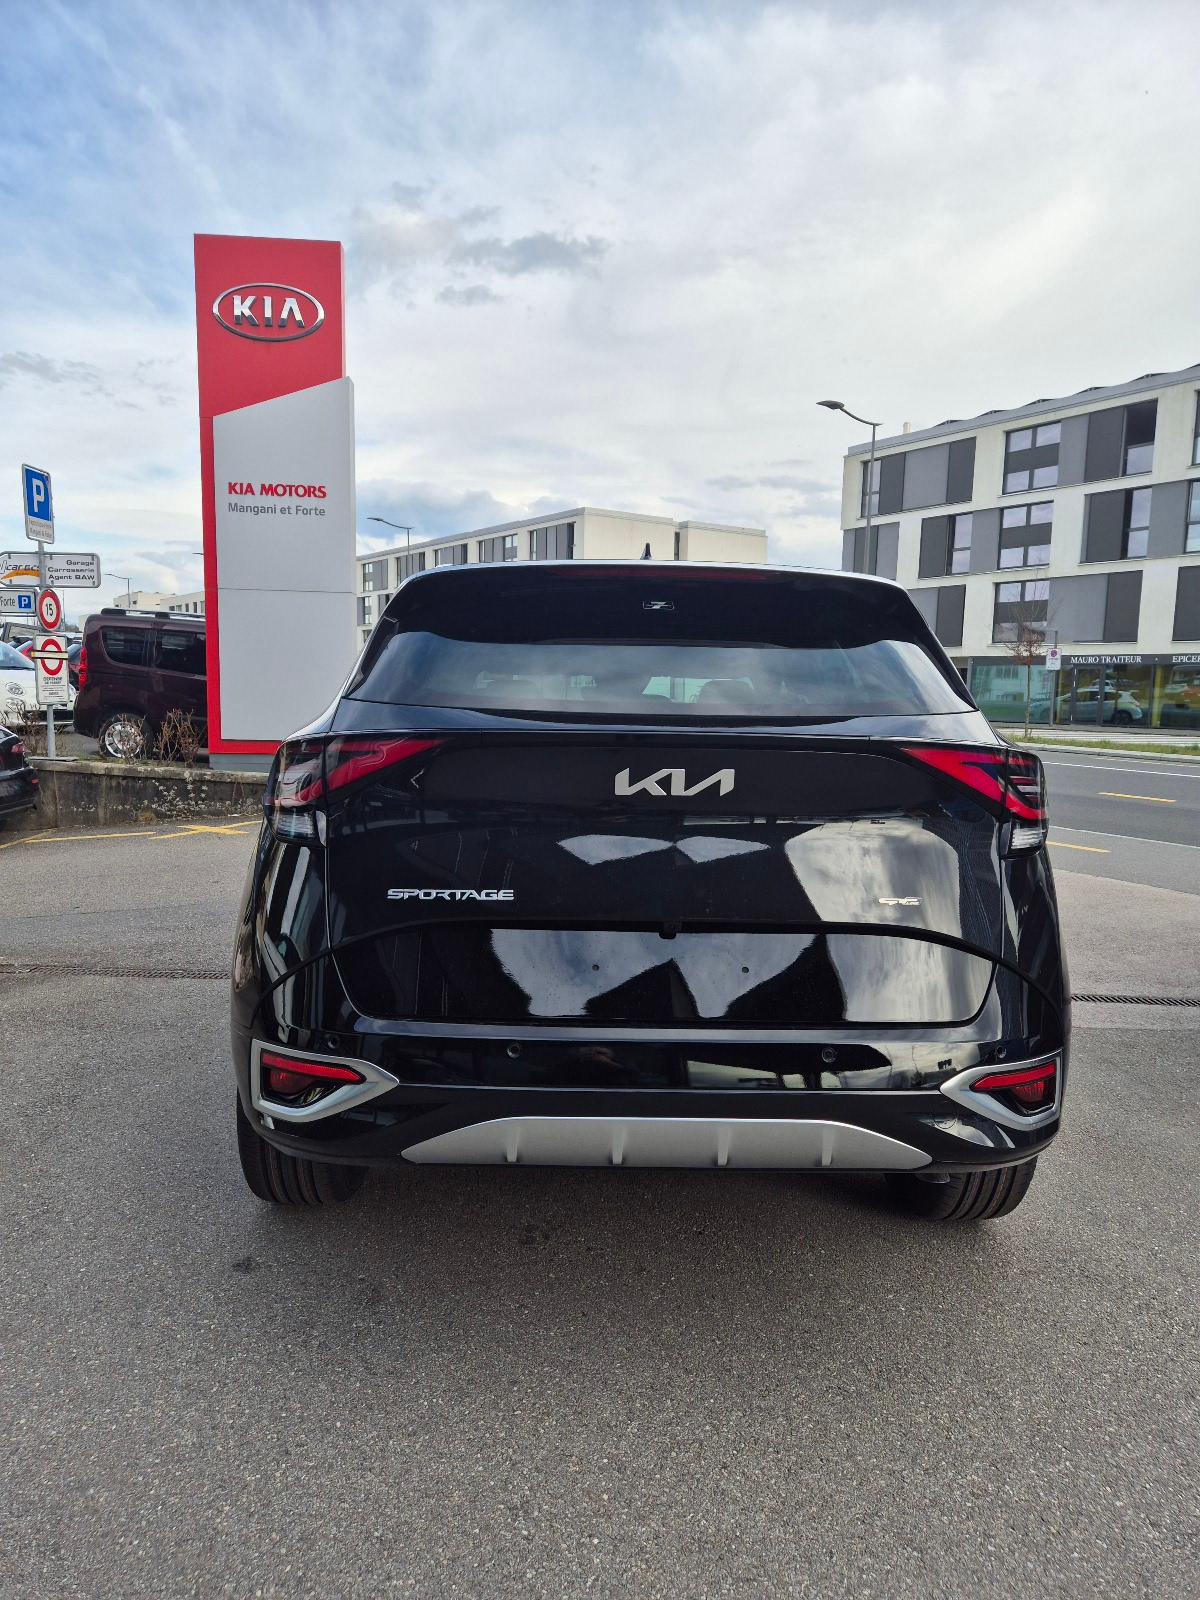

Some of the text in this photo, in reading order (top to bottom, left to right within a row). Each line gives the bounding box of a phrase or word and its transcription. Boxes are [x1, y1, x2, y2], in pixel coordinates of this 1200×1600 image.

[232, 295, 305, 328] KIA
[32, 478, 45, 512] P
[228, 482, 327, 499] KIA MOTORS
[228, 502, 326, 516] Mangani et Forte
[66, 559, 95, 567] Garage
[45, 603, 54, 617] 15
[1070, 656, 1099, 664] MAURO
[1101, 656, 1142, 664] TRAITEUR
[614, 767, 735, 797] KIA
[387, 888, 515, 901] SPORTAGE
